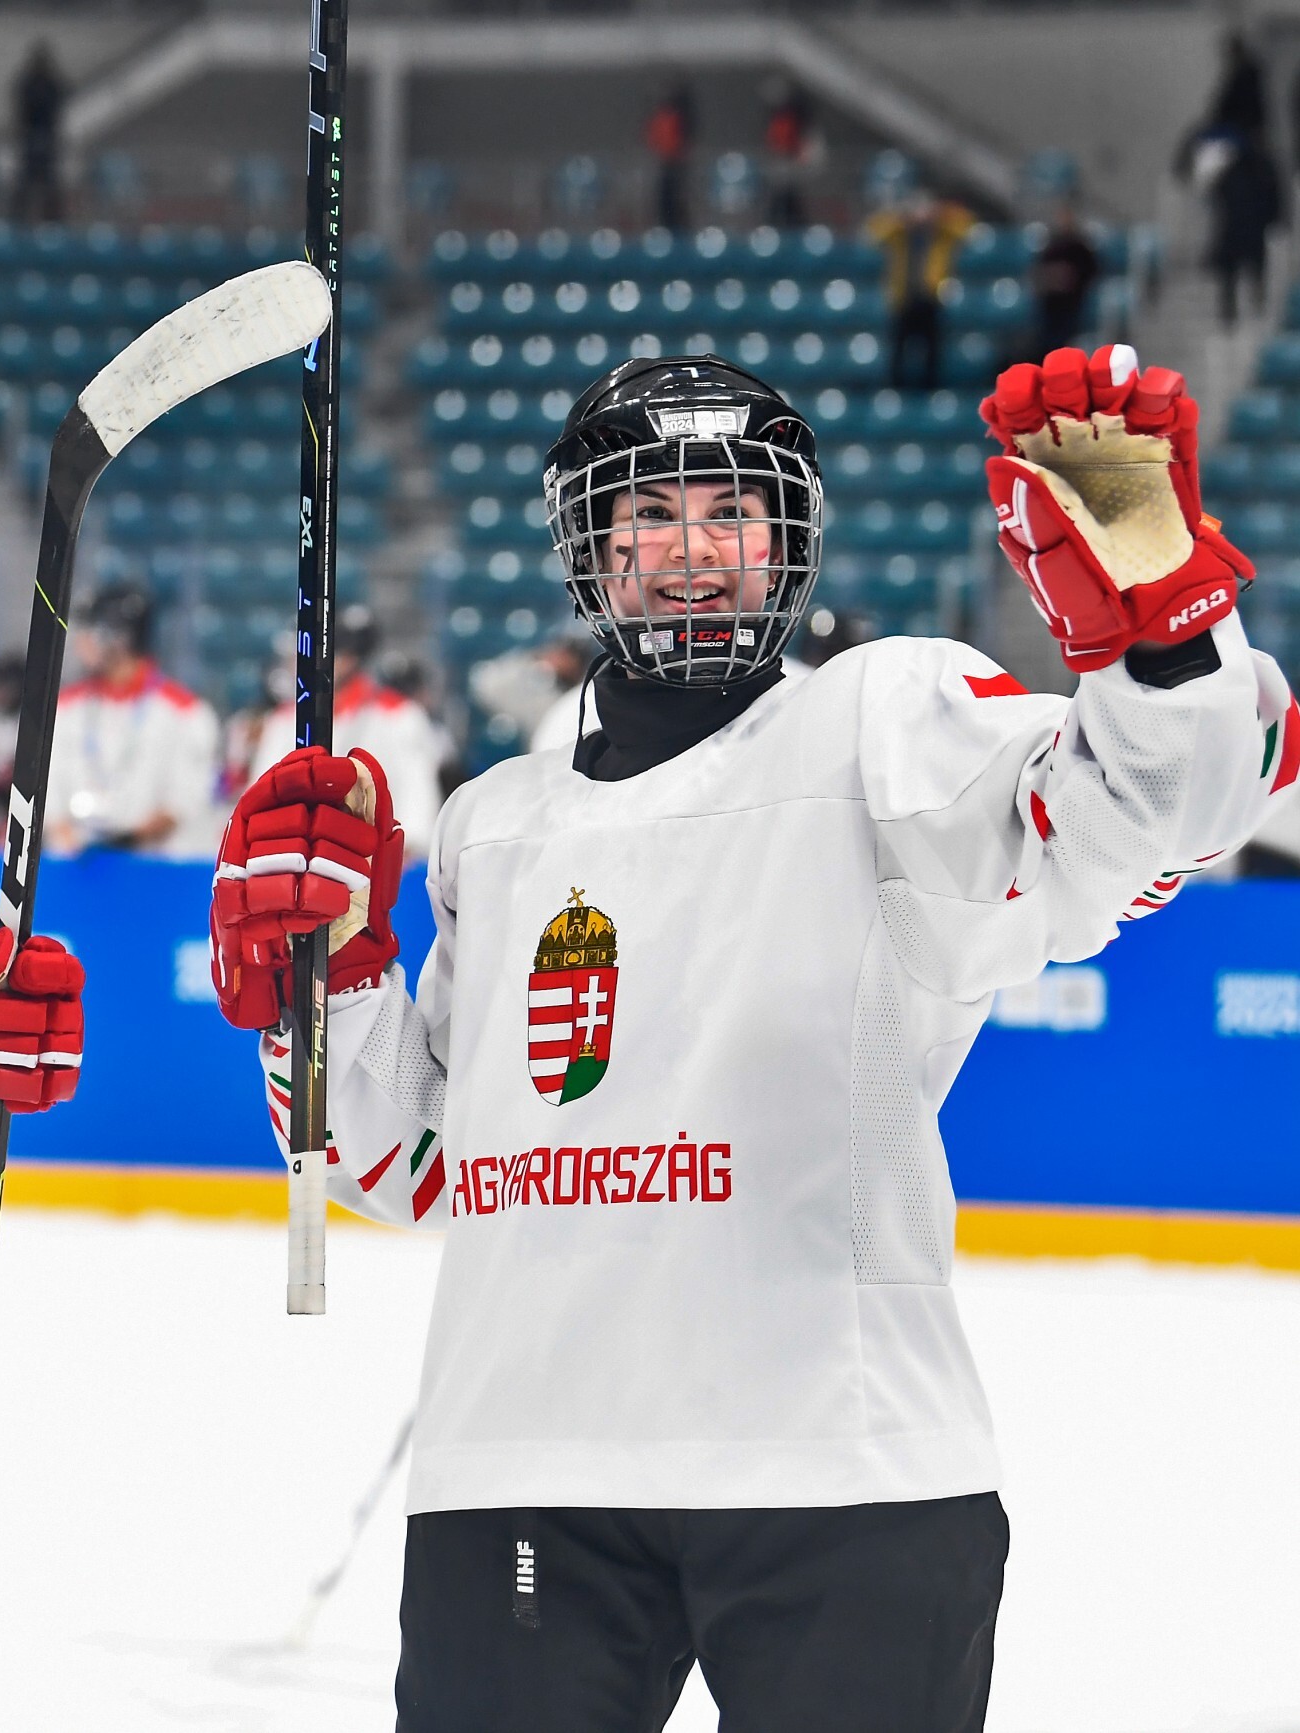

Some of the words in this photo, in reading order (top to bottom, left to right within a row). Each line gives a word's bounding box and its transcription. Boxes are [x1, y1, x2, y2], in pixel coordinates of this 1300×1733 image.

[661, 420, 694, 433] 2024
[1168, 588, 1229, 633] CCM
[313, 978, 325, 1079] TRUE
[452, 1131, 732, 1217] AGYARORSZÁG
[516, 1540, 535, 1594] IIHF
